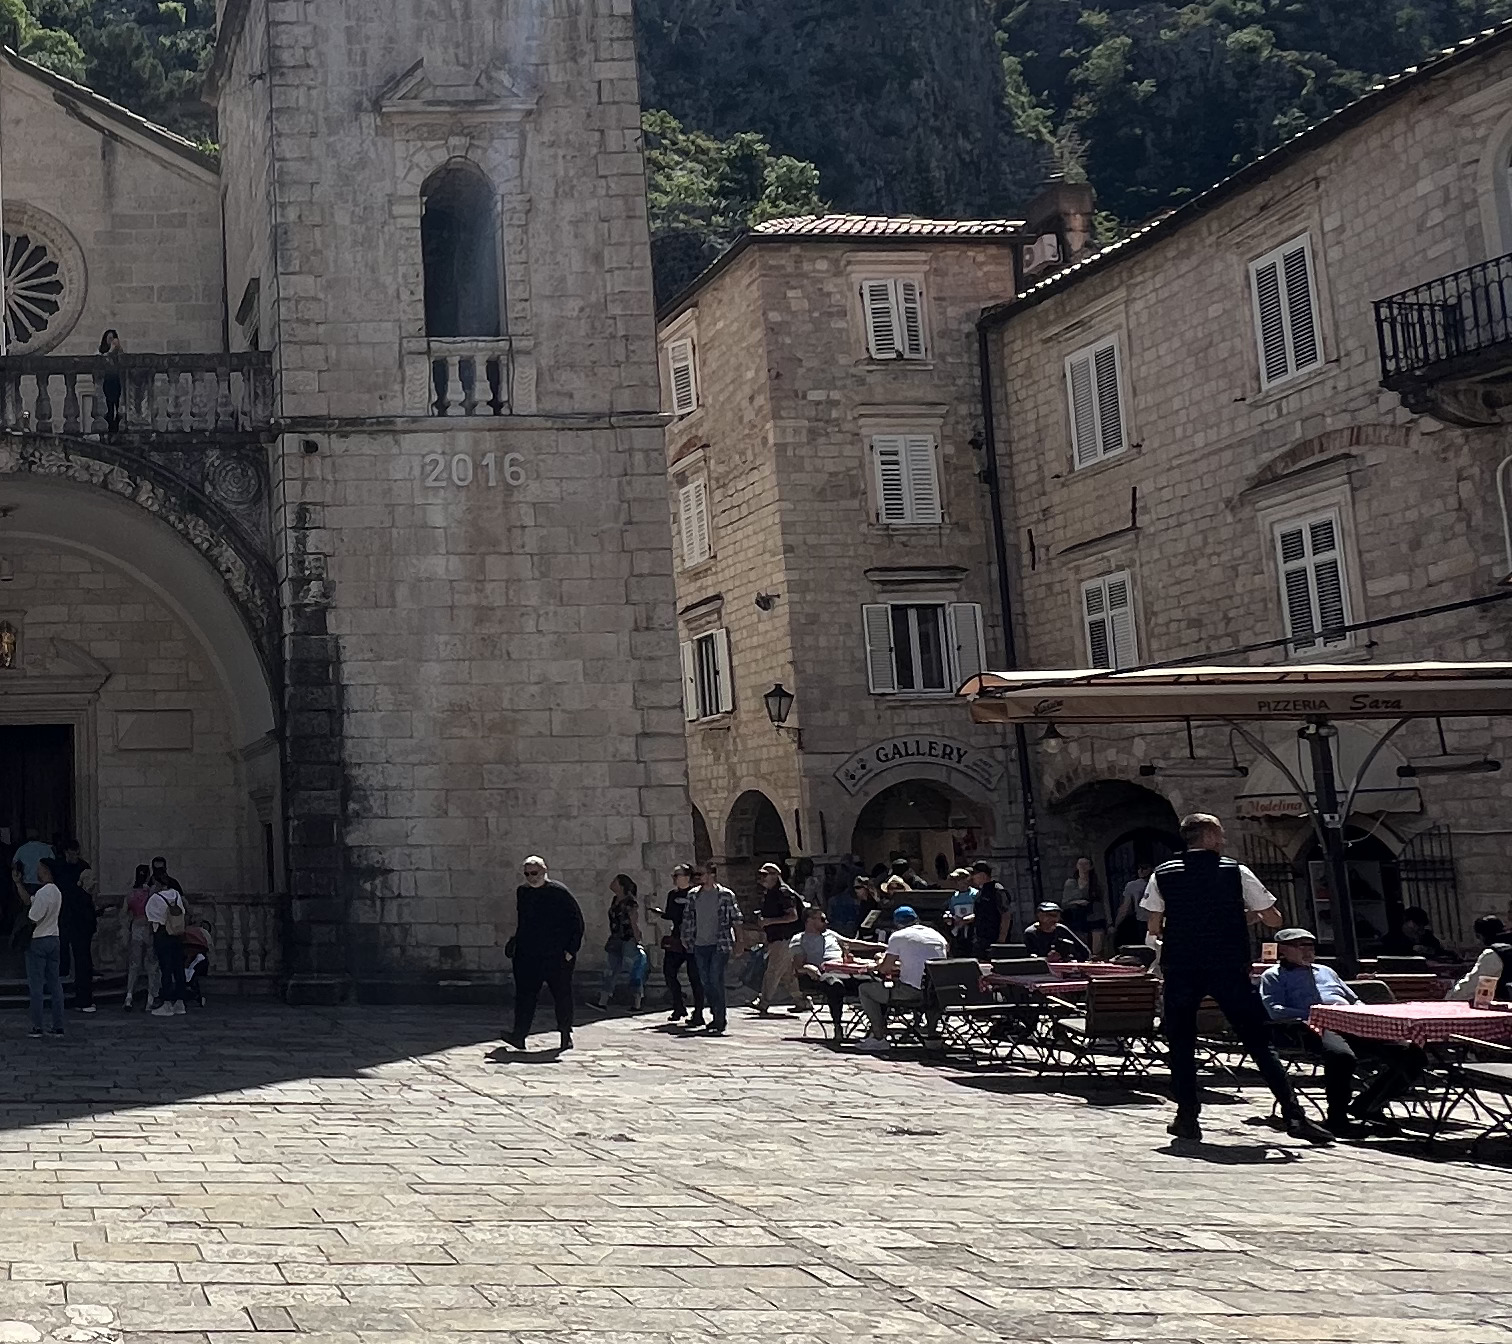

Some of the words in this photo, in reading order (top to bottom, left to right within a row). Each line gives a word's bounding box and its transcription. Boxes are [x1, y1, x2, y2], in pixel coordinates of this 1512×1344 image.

[423, 452, 527, 487] 2016
[1257, 699, 1331, 712] PIZZERIA
[1349, 693, 1402, 711] Sara
[875, 739, 968, 764] GALLERY
